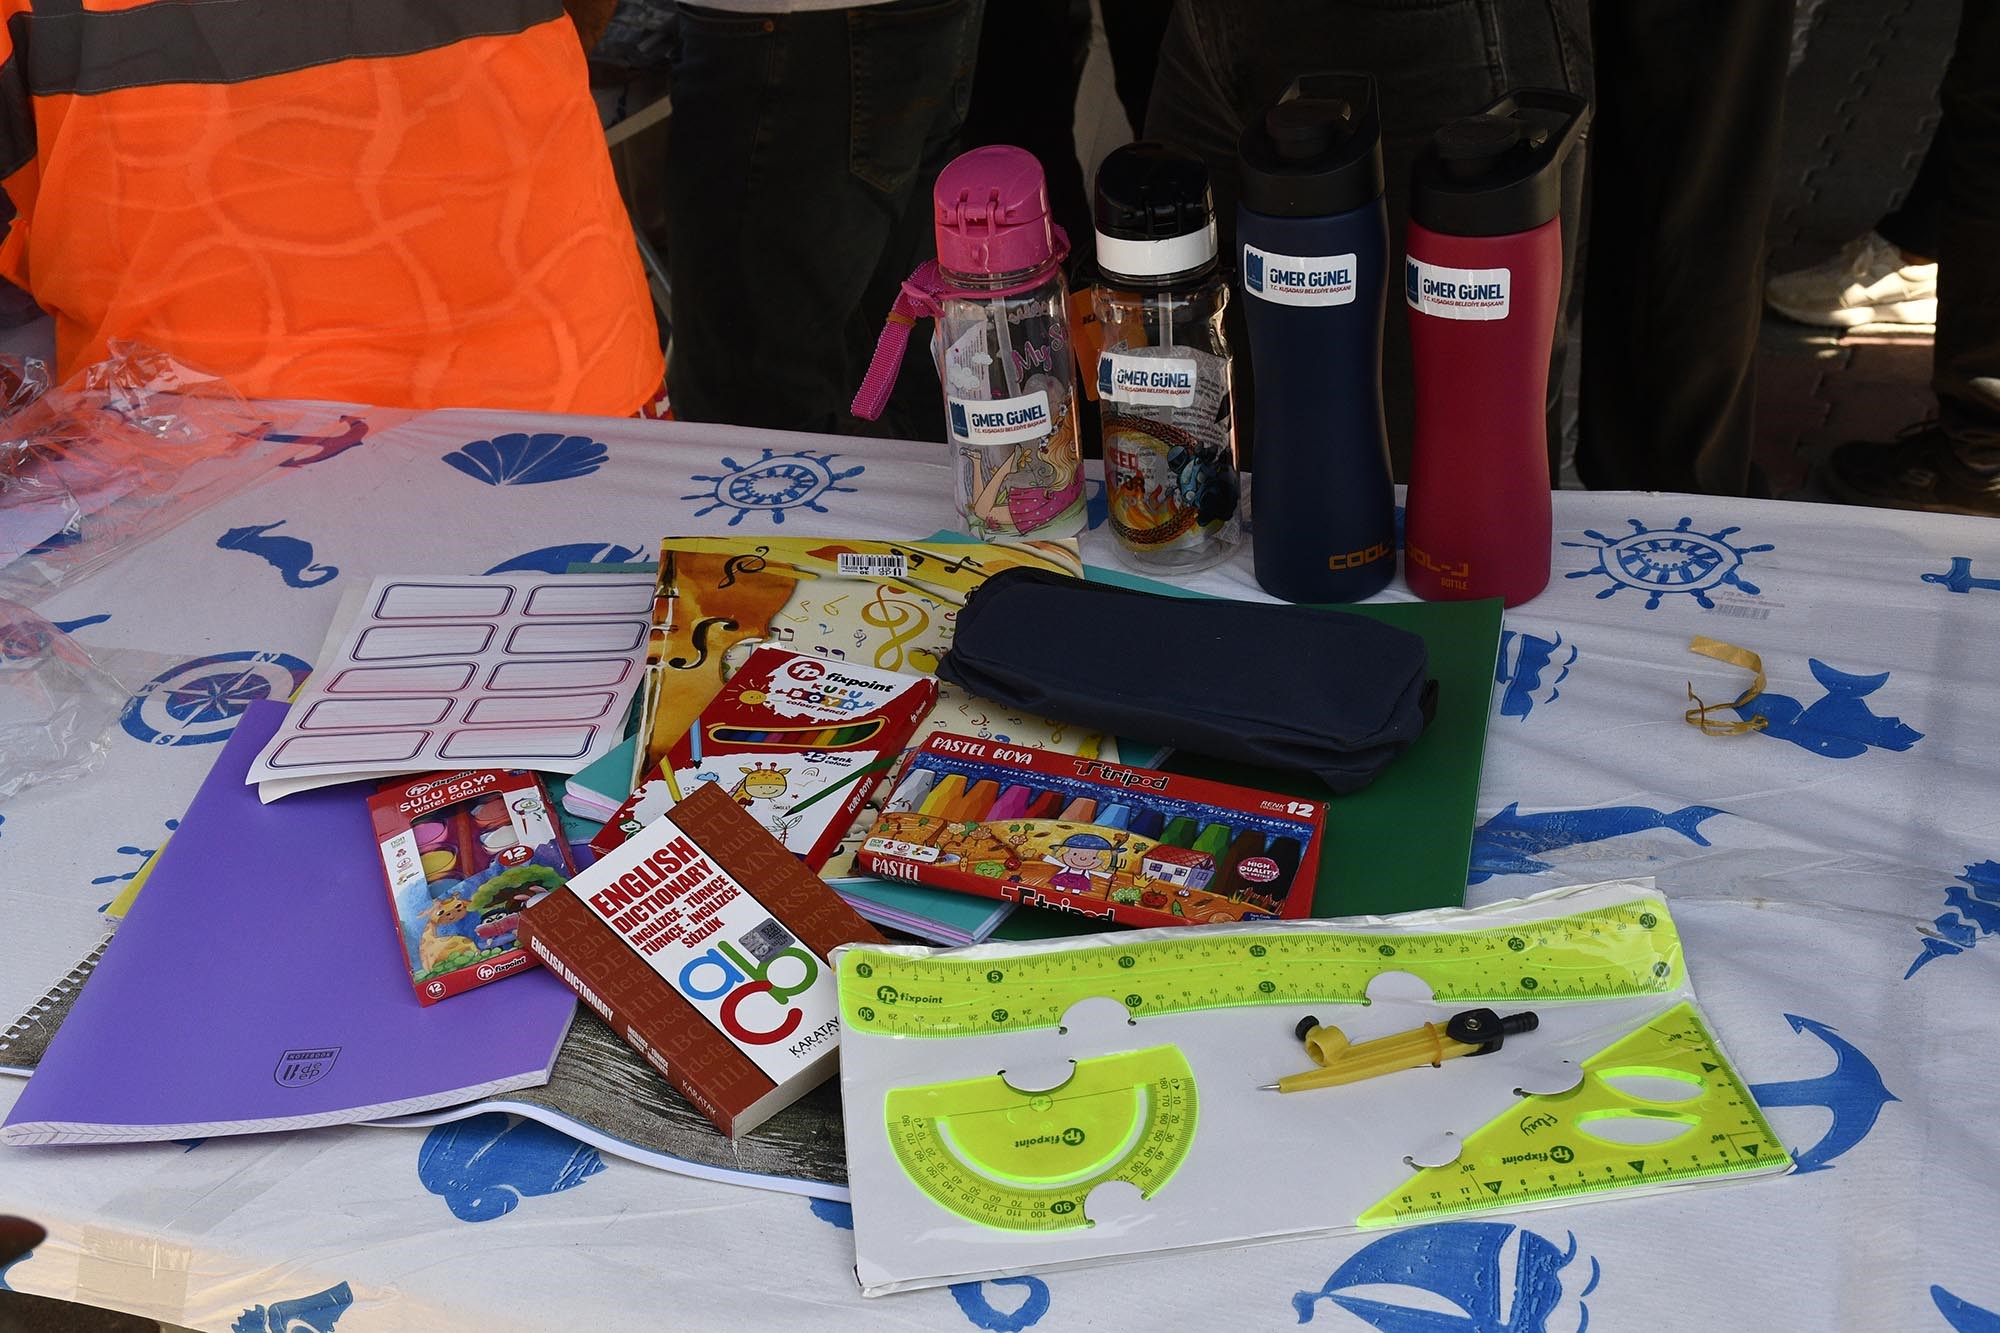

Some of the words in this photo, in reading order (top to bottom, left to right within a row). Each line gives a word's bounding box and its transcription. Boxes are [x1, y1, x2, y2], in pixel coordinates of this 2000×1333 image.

[1270, 268, 1305, 286] ÖMER
[1309, 269, 1351, 286] GÜNEL
[1424, 279, 1456, 298] ÖMER
[1459, 284, 1504, 299] GÜNEL
[1117, 369, 1148, 387] ÖMER
[1151, 372, 1191, 388] GÜNEL
[971, 412, 1004, 427] ÖMER
[1007, 404, 1046, 424] GÜNEL
[1441, 577, 1468, 590] BOTTLE
[256, 653, 278, 662] N
[812, 683, 863, 698] KURU
[826, 673, 894, 692] fixpoint
[786, 700, 817, 710] colour
[817, 706, 848, 715] pencil
[155, 735, 174, 745] S
[931, 737, 986, 757] PASTEL
[993, 748, 1033, 765] BOYA
[1100, 766, 1170, 791] tripod
[400, 790, 443, 812] SULU
[448, 774, 496, 794] BOYA
[414, 797, 447, 813] water
[450, 786, 487, 800] colour
[1261, 800, 1286, 809] RENK
[1287, 801, 1314, 818] 12
[503, 846, 527, 860] 12
[872, 857, 920, 881] PASTEL
[1240, 866, 1278, 876] QUALITY
[1247, 861, 1270, 869] HIGH
[589, 836, 700, 918] ENGLISH
[612, 858, 713, 934] DICTIONARY
[628, 907, 684, 946] İNGİLİZCE
[684, 875, 729, 909] TÜRKÇE
[640, 923, 688, 956] TÜRKÇE
[687, 885, 741, 926] İNGİLİZCE
[681, 916, 725, 949] SÖZLÜK
[991, 972, 998, 982] 5
[1120, 957, 1133, 967] 10
[1252, 947, 1264, 956] 15
[1381, 946, 1393, 955] 20
[1510, 939, 1523, 949] 25
[1642, 916, 1656, 926] 30
[495, 956, 527, 973] fixpoint
[531, 935, 564, 976] ENGLISH
[564, 967, 614, 1021] DICTIONARY
[428, 983, 442, 993] 12
[900, 993, 943, 1004] fixpoint
[860, 1009, 873, 1019] 30
[994, 1010, 1006, 1020] 25
[789, 1016, 840, 1056] KARATAY
[682, 1079, 717, 1114] KARATAY
[1014, 1135, 1060, 1148] fixpoint
[1502, 1153, 1549, 1166] fixpoint
[1006, 1209, 1022, 1217] 110
[1034, 1201, 1045, 1209] 80
[1055, 1202, 1071, 1213] 90
